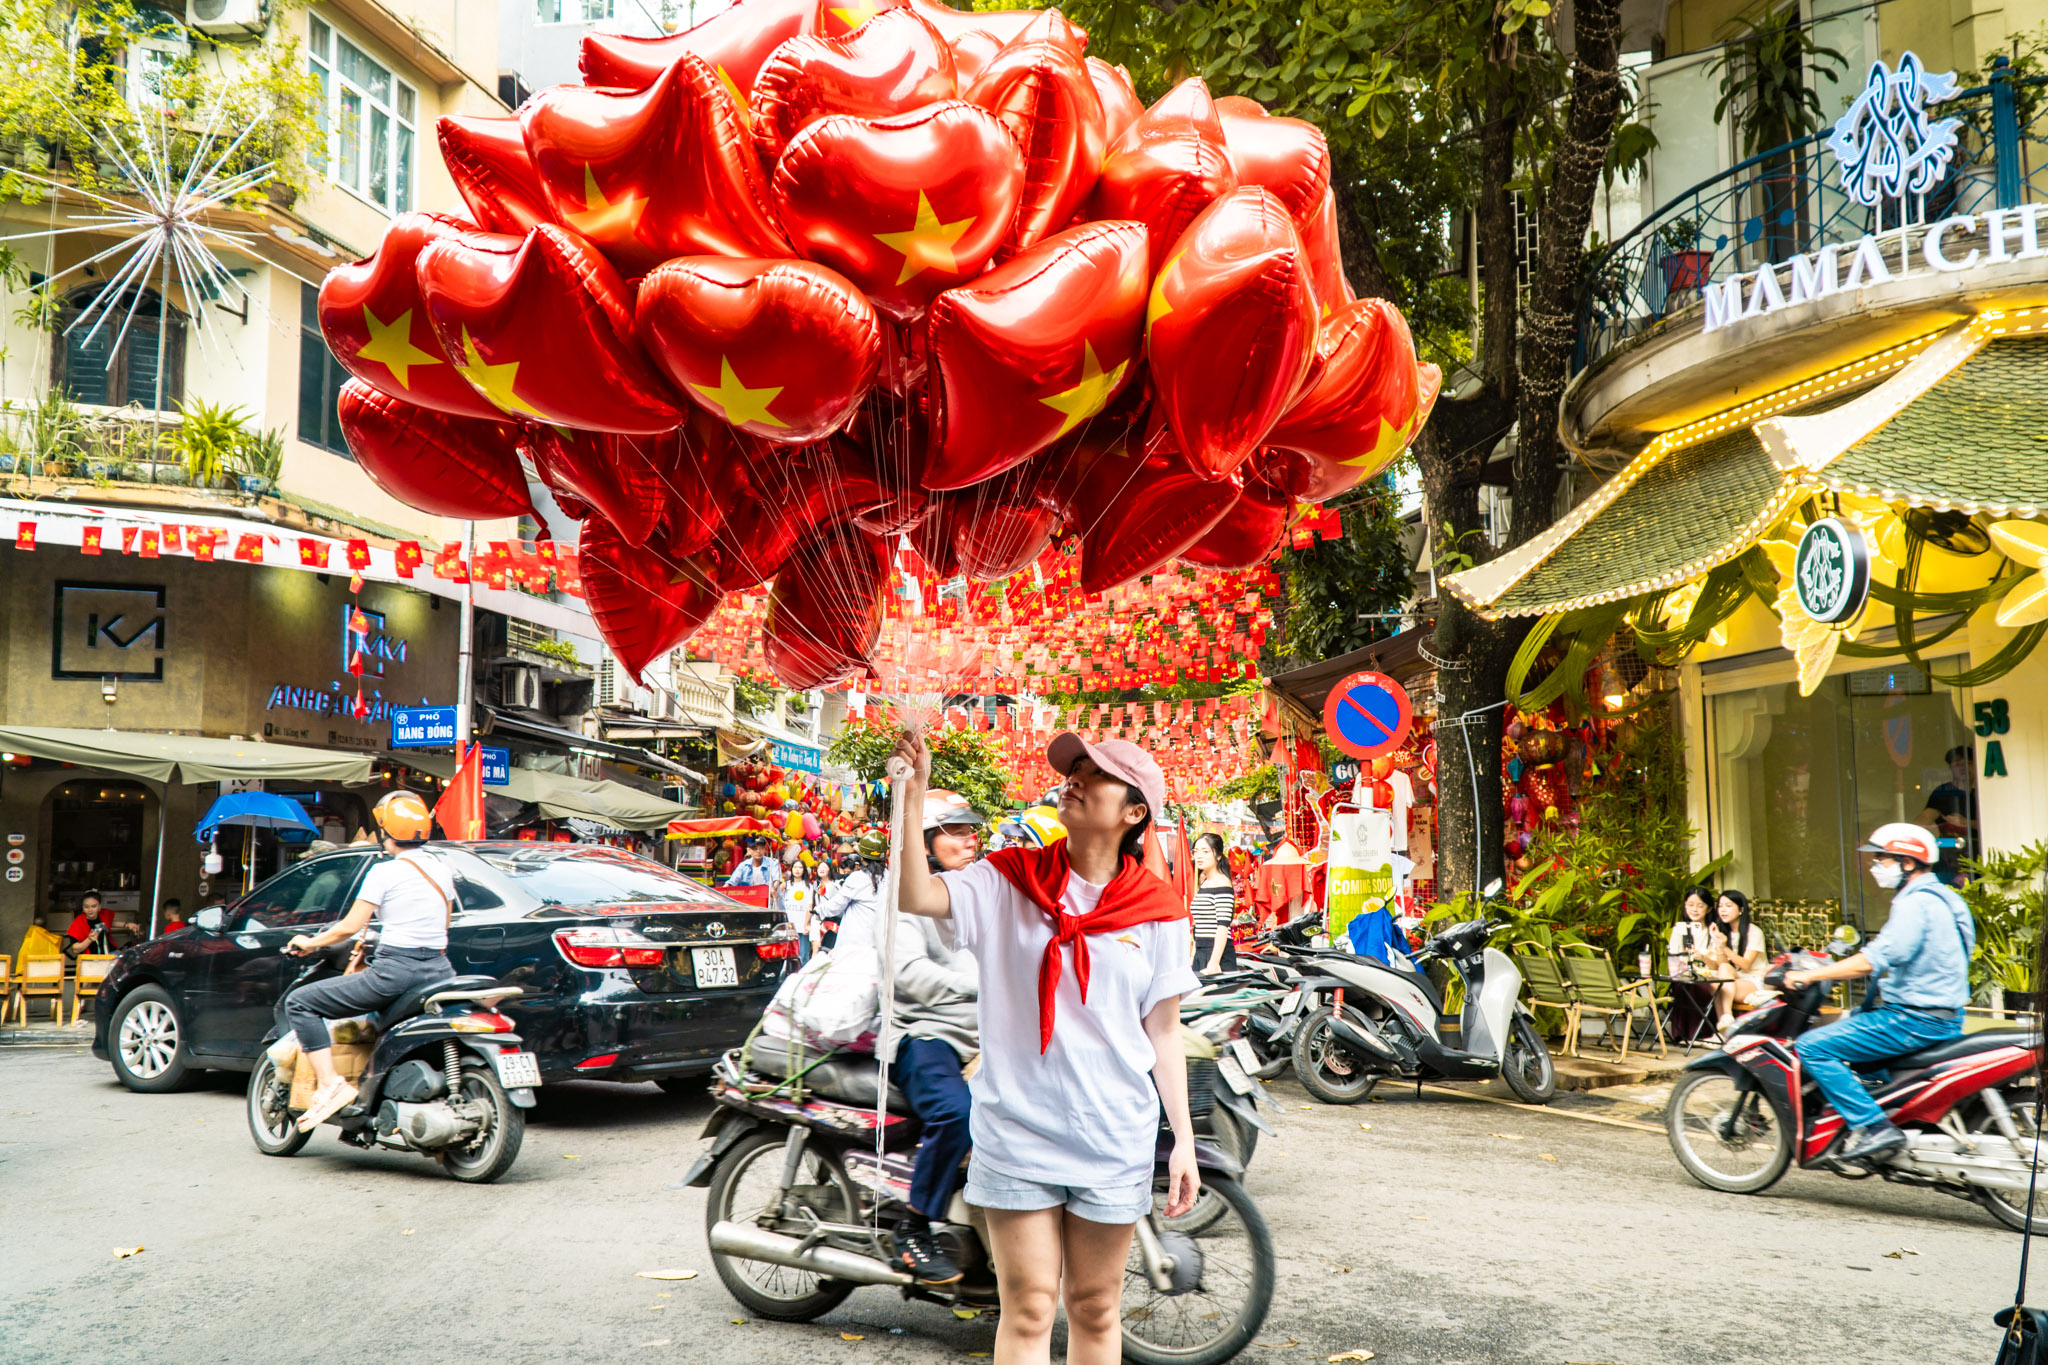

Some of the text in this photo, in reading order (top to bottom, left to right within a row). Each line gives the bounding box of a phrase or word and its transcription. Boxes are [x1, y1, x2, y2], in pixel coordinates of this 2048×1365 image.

[1702, 233, 1896, 334] MAMA
[419, 710, 441, 721] PHỐ
[1974, 697, 2010, 737] 58
[398, 724, 425, 740] HÀNG
[1984, 740, 2008, 777] A
[1335, 763, 1359, 780] 60
[1332, 879, 1371, 895] COMING
[1372, 877, 1393, 893] SOON
[703, 949, 726, 967] 30A
[698, 967, 737, 985] 847.32
